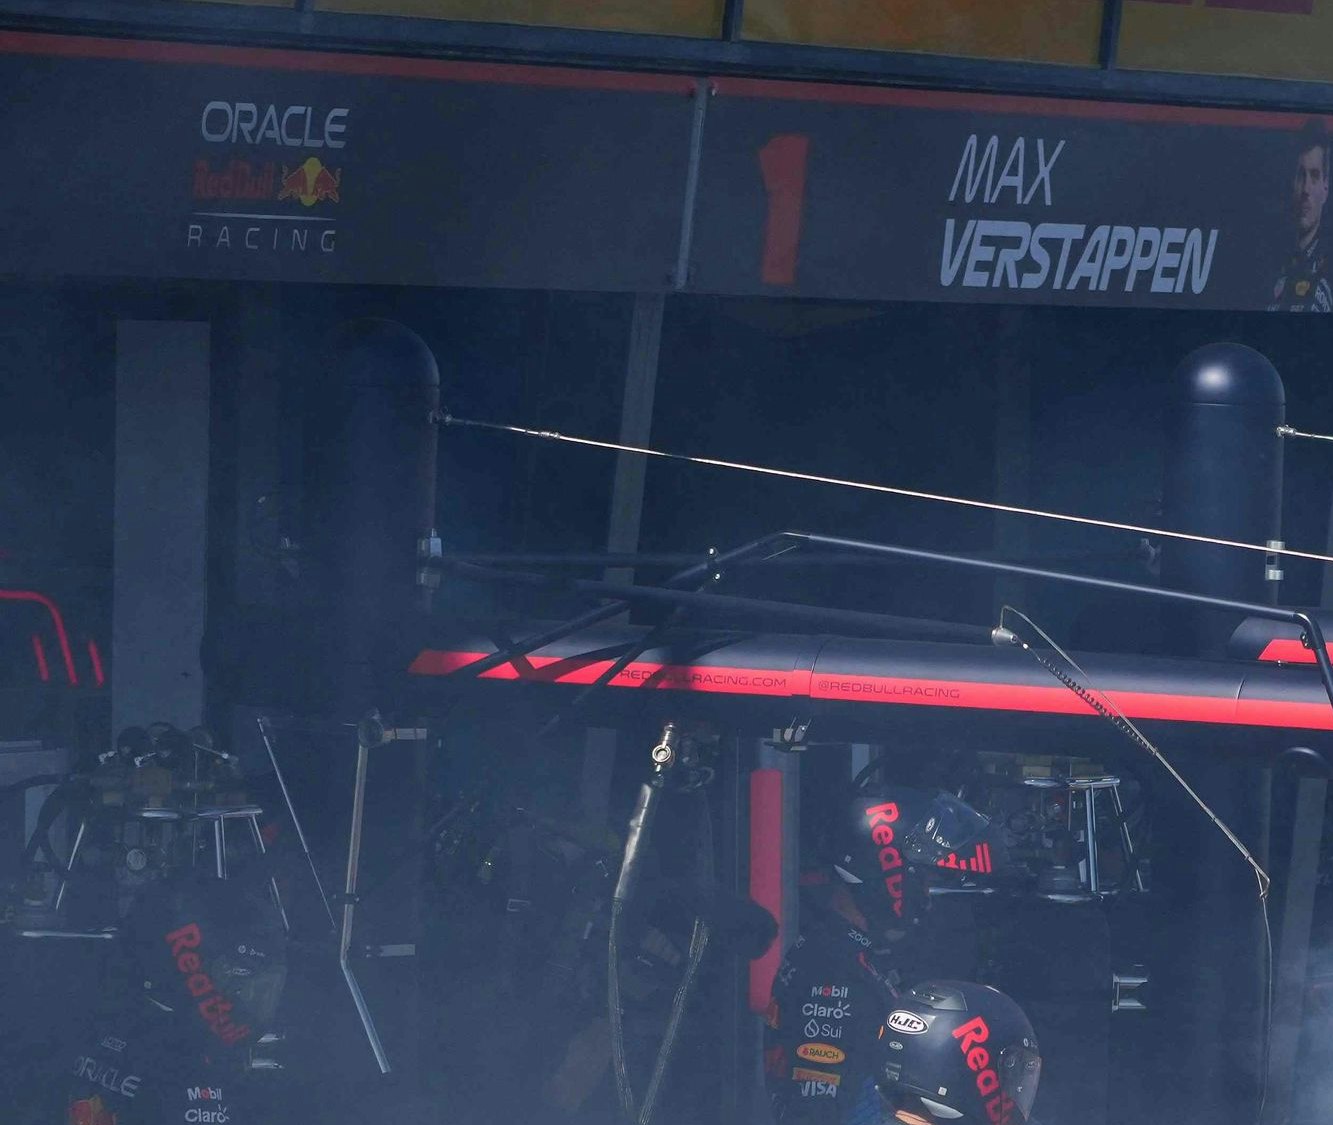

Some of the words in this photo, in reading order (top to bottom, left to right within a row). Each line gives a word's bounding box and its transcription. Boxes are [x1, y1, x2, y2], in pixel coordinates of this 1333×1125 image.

[202, 101, 350, 148] ORACLE
[949, 134, 1065, 205] MAX
[759, 135, 809, 284] 1
[188, 224, 337, 252] RACING
[940, 219, 1218, 294] VERSTAPPEN
[818, 679, 960, 699] @REDBULLRACING
[811, 985, 848, 998] Mobil
[802, 1002, 845, 1019] Claro
[891, 1014, 922, 1030] HJC
[822, 1024, 842, 1039] Sui
[809, 1048, 839, 1060] RAUCH
[186, 1087, 223, 1101] Mobil
[800, 1080, 838, 1098] VISA
[184, 1106, 228, 1125] Claro
